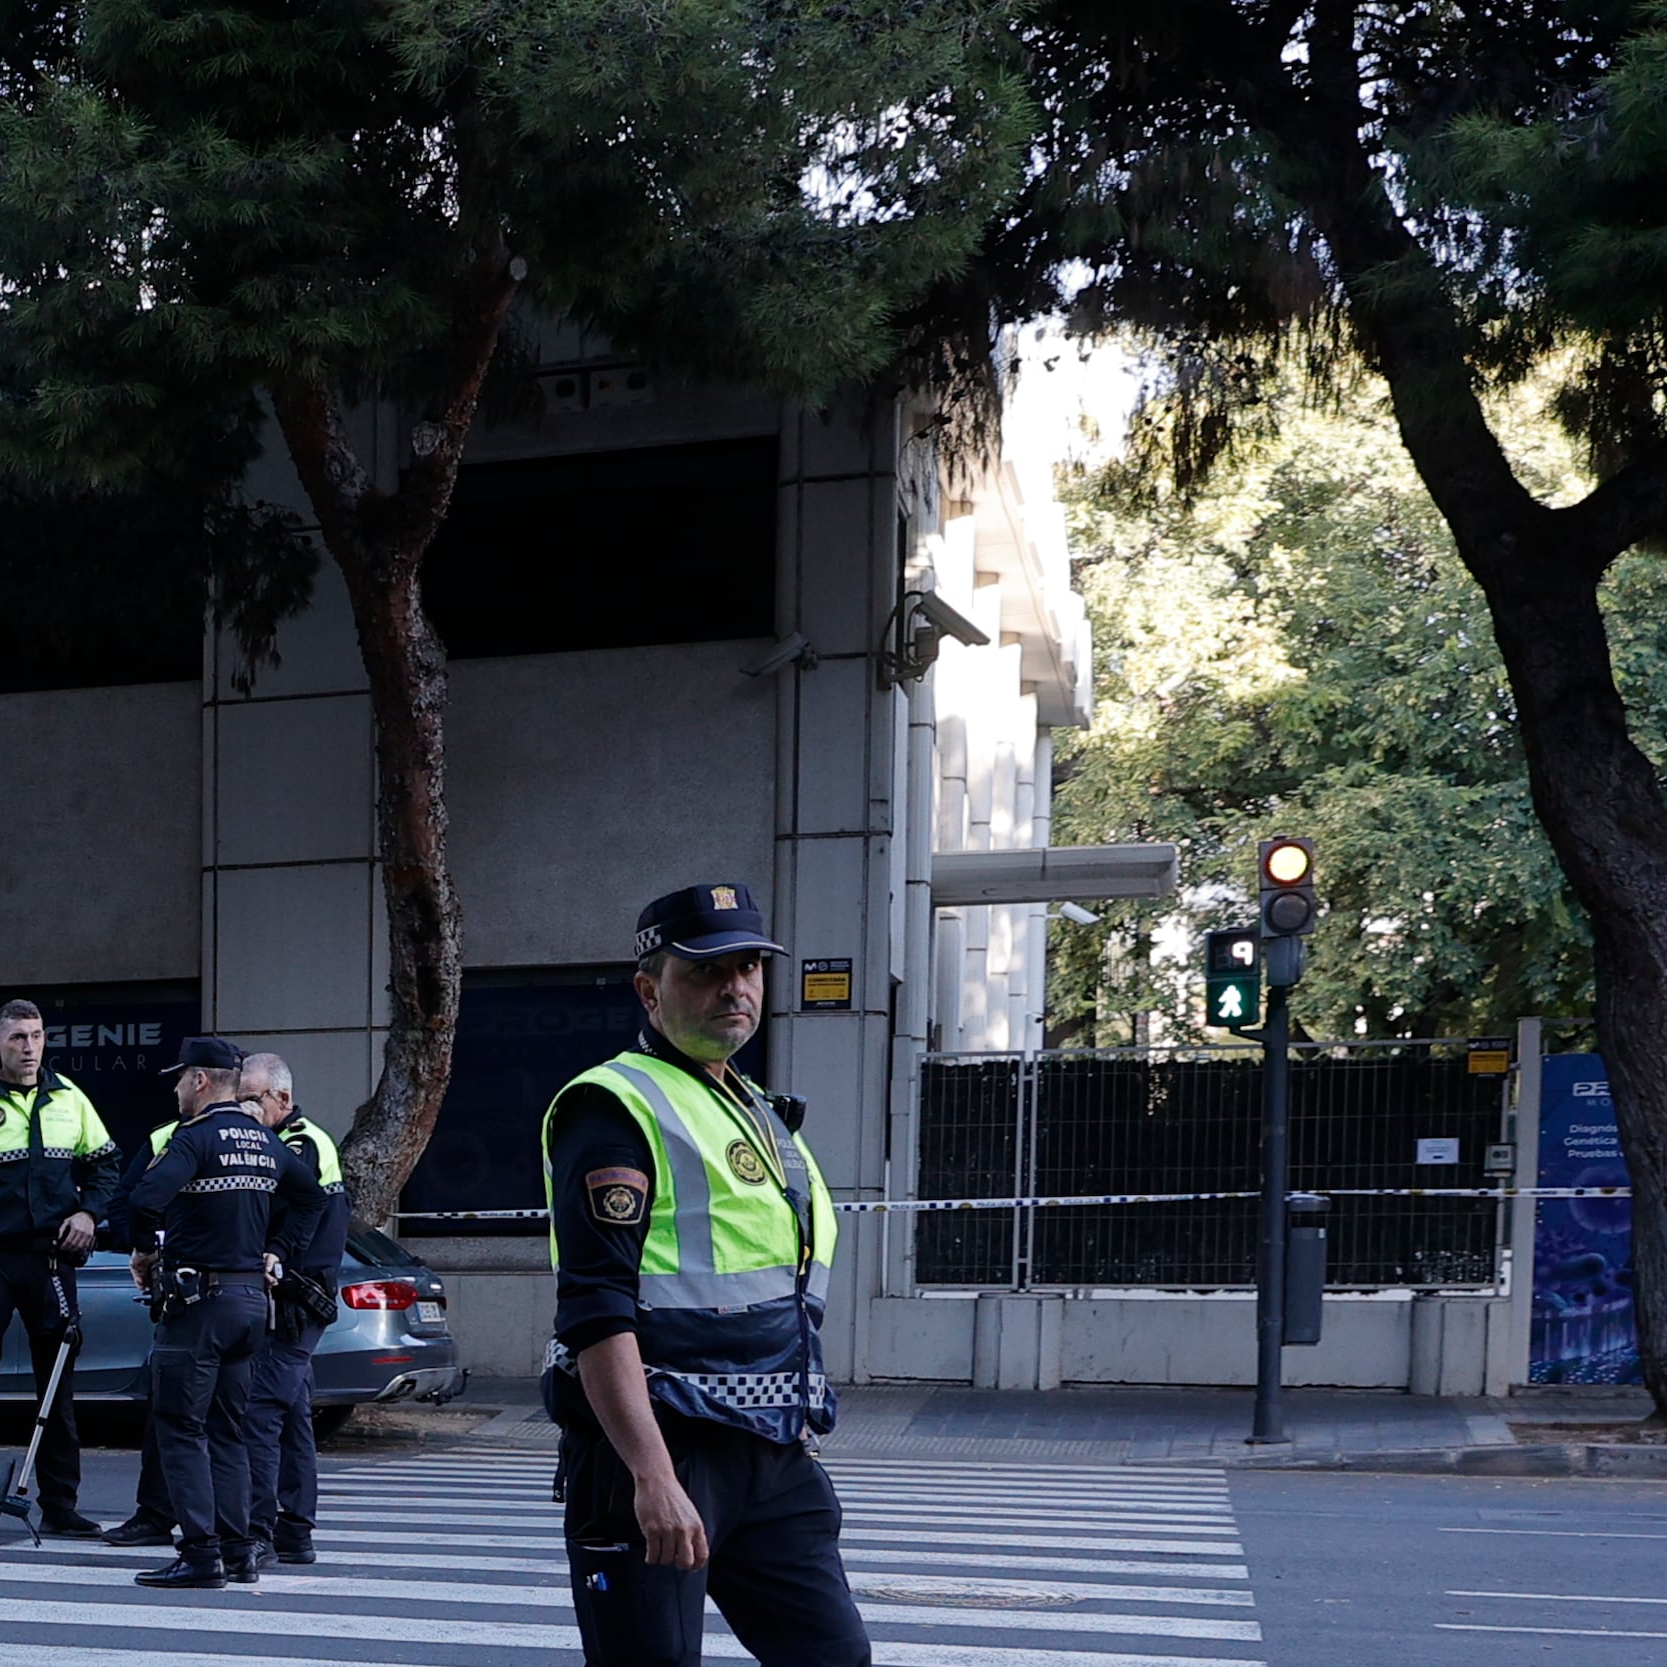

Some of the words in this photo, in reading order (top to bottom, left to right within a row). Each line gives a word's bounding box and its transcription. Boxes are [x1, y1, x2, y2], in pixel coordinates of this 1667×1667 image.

[1231, 940, 1254, 966] 9
[218, 1127, 269, 1144] POLICIA
[235, 1141, 262, 1150] LOCAL
